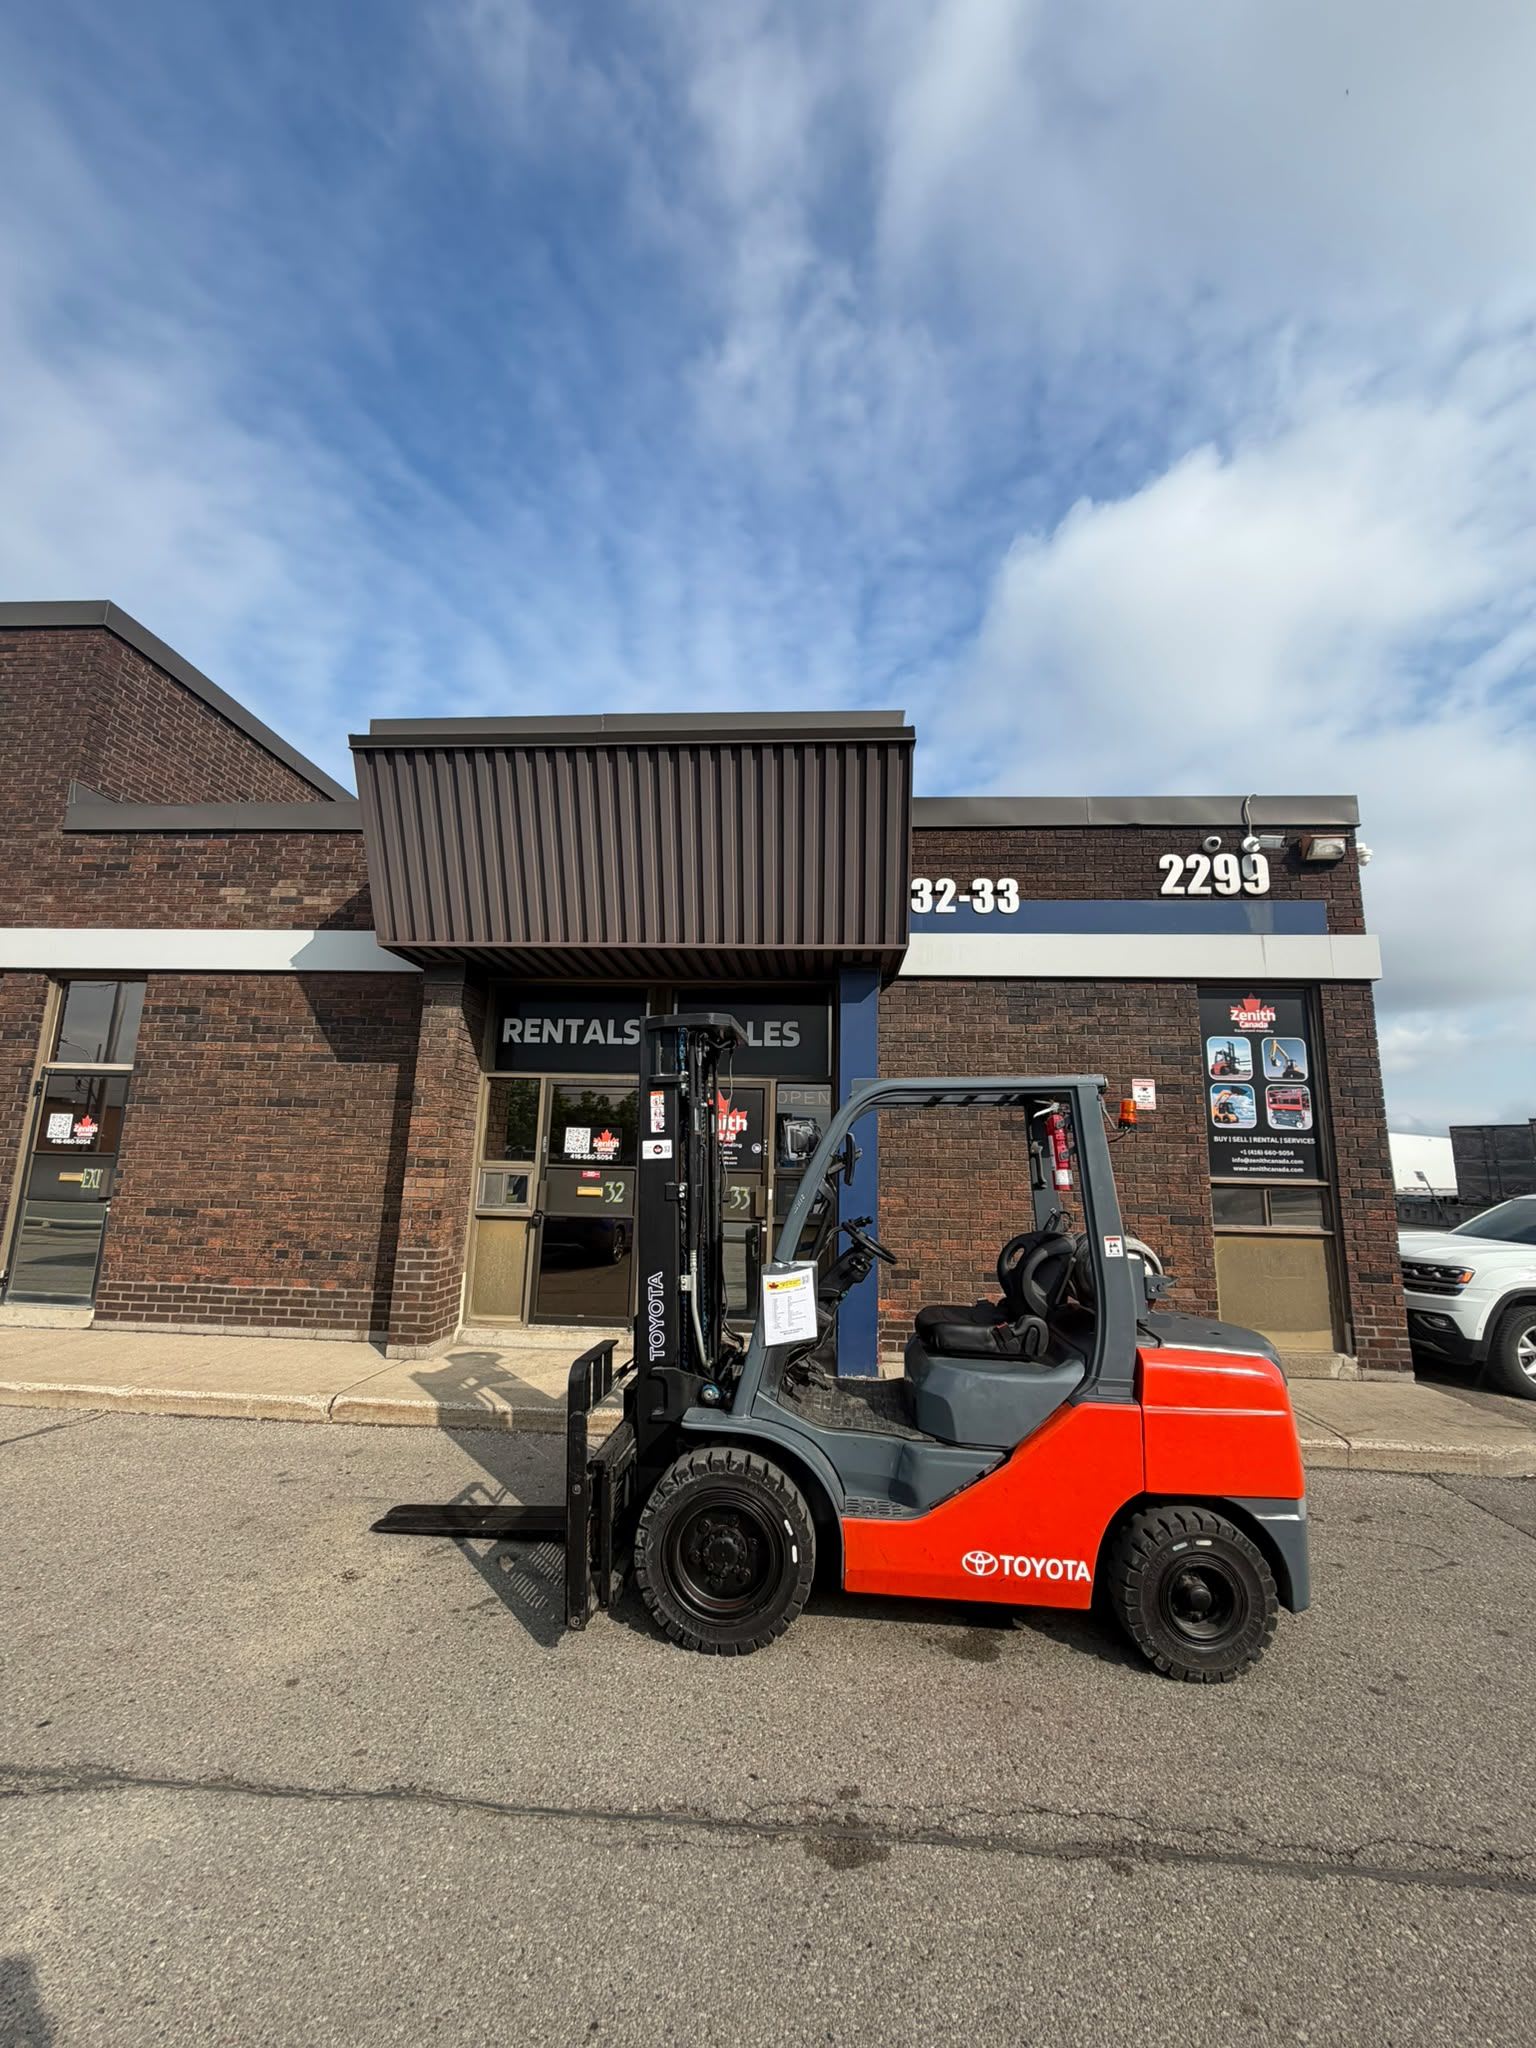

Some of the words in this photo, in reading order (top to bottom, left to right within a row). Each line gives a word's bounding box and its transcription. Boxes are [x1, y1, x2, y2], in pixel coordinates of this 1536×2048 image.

[1158, 853, 1270, 895] 2299
[911, 878, 1020, 914] 32-33
[1230, 1009, 1276, 1021] Zenith
[1239, 1020, 1269, 1029] Canada
[502, 1018, 640, 1045] RENTALS
[747, 1021, 800, 1047] LES
[777, 1091, 830, 1105] OPEN
[73, 1124, 98, 1133] Zenith
[1284, 1137, 1316, 1145] SERVICES
[1231, 1157, 1304, 1165] info@zenithcanada.com
[1264, 1149, 1294, 1157] 660-5054
[81, 1168, 103, 1188] EXI
[605, 1181, 625, 1203] 32
[730, 1186, 751, 1210] 33
[647, 1271, 666, 1362] TOYOTA
[1000, 1554, 1092, 1582] TOYOTA
